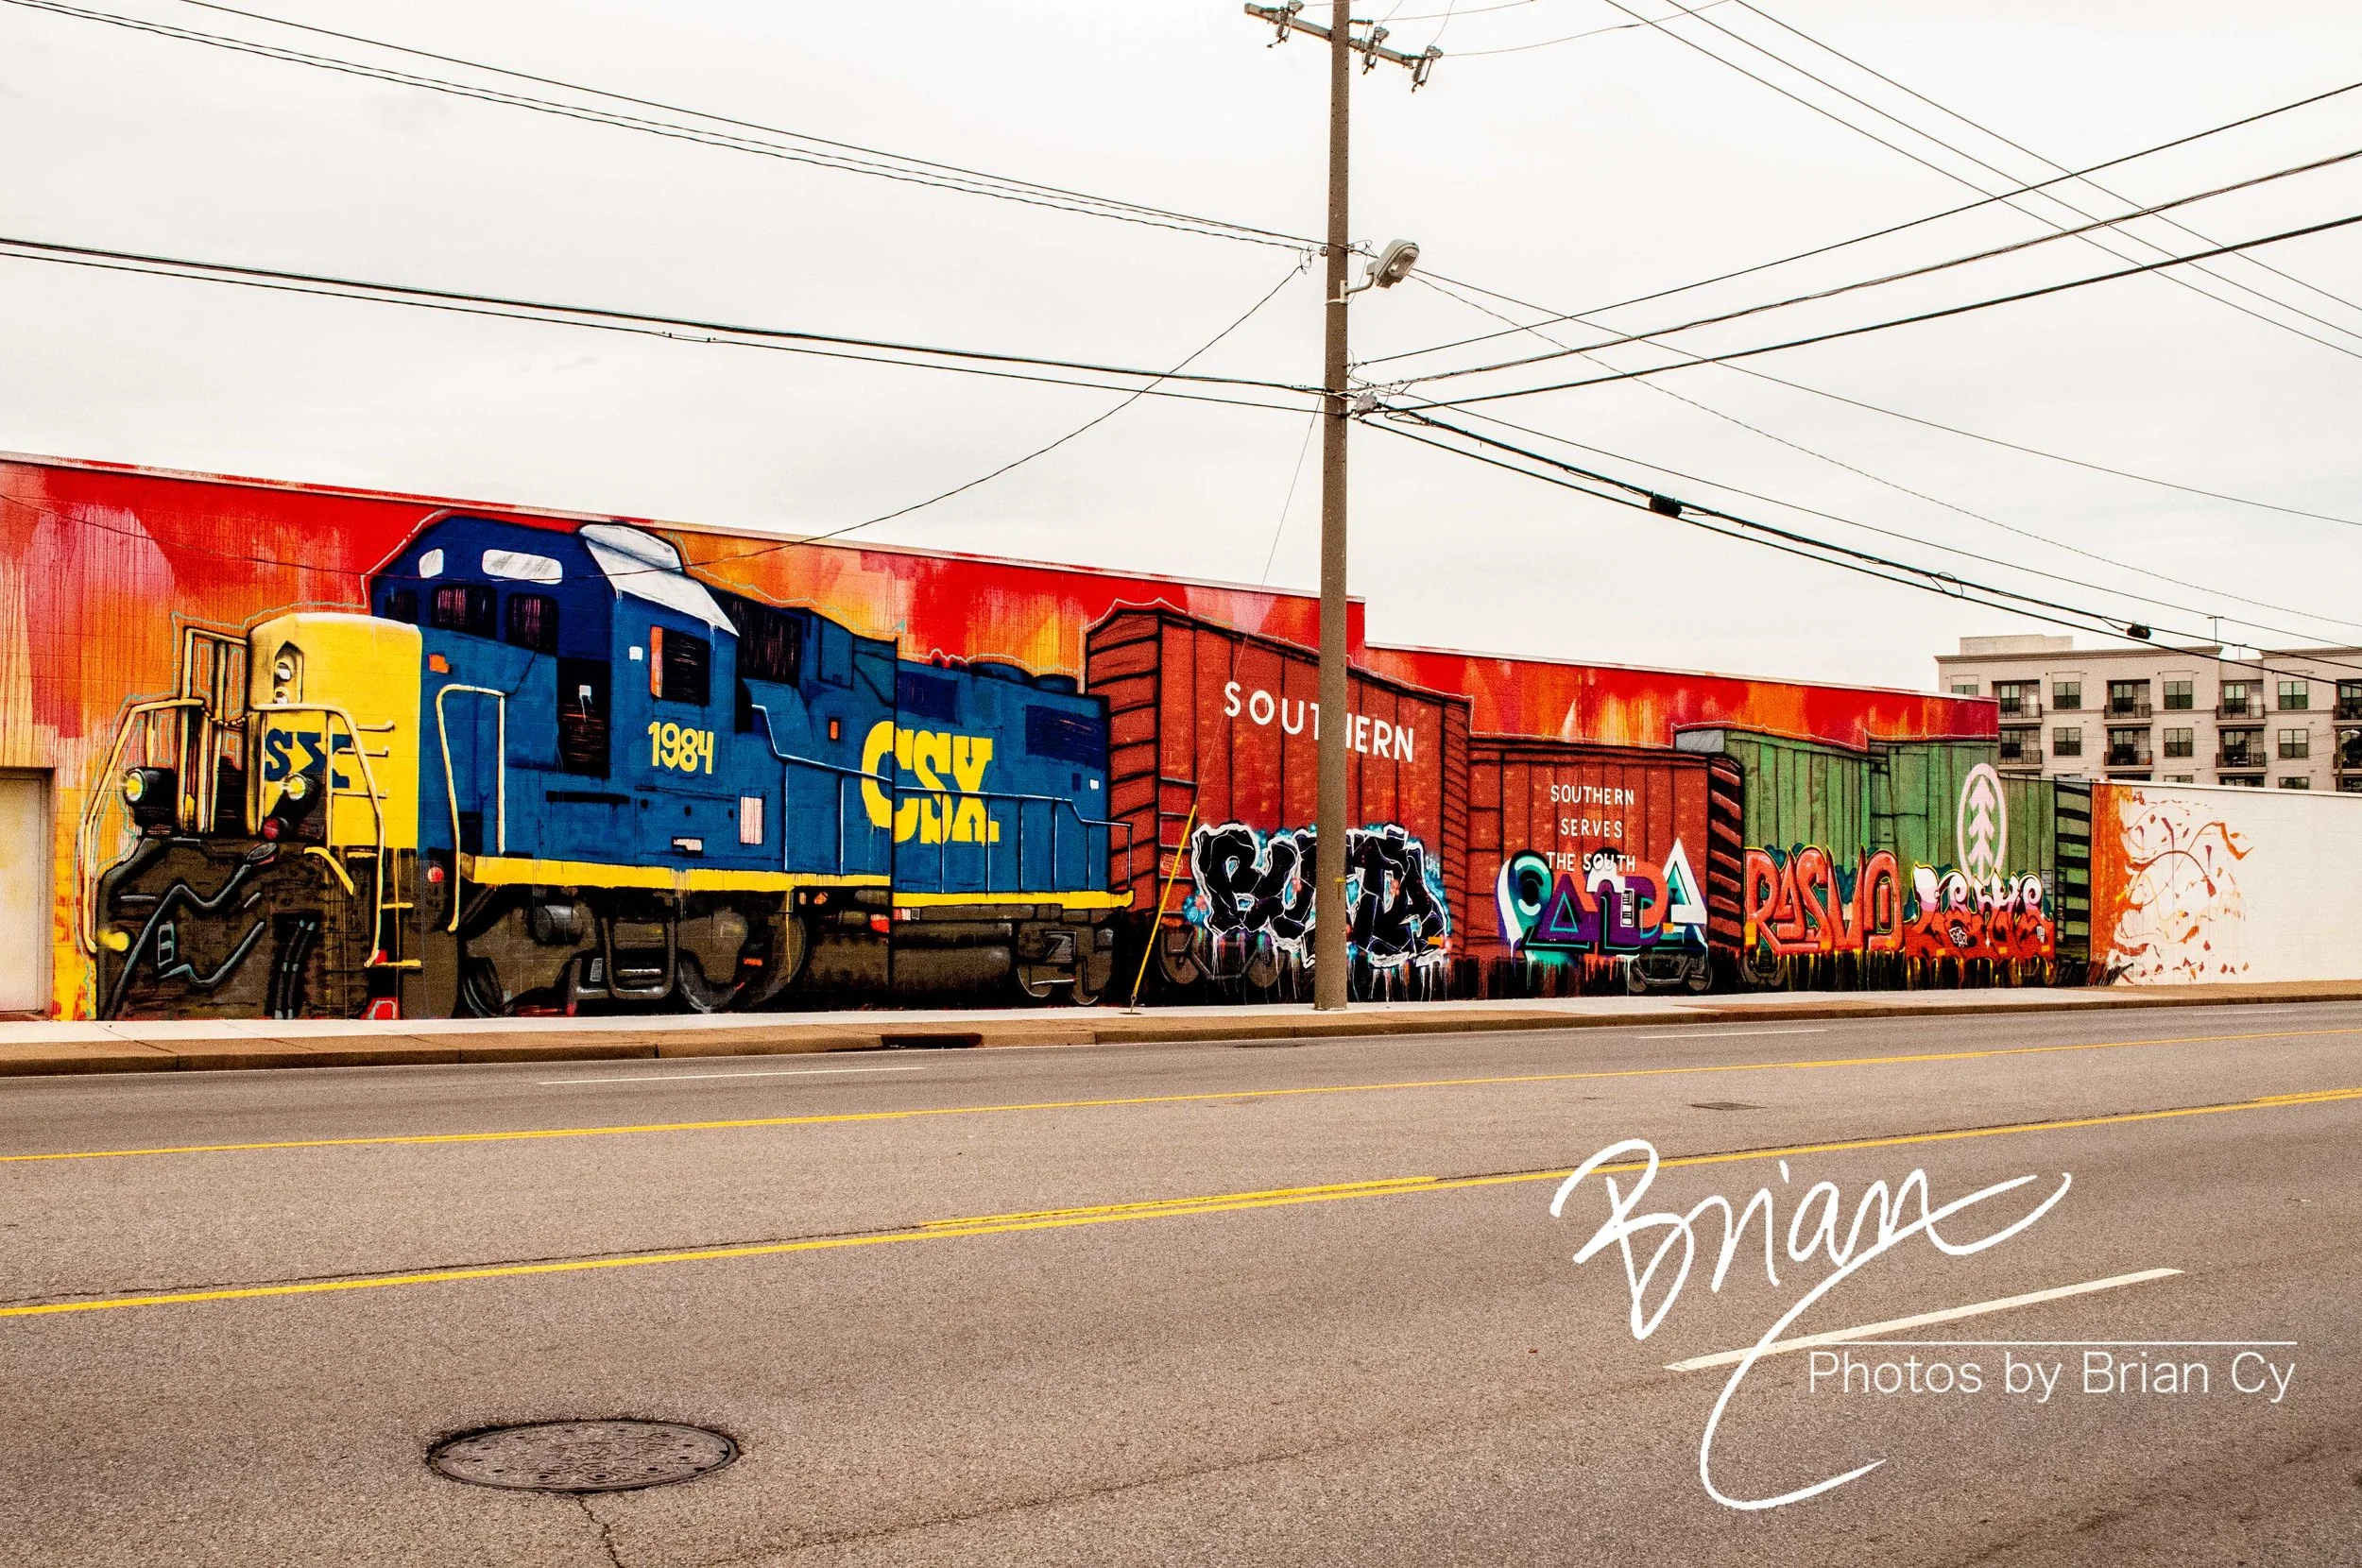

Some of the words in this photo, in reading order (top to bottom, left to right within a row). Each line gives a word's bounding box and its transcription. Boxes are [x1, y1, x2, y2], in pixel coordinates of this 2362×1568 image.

[648, 721, 713, 775] 1984
[861, 720, 1001, 846] CSX
[1550, 784, 1635, 806] SOUTHERN
[1560, 818, 1623, 839] SERVES
[1546, 851, 1576, 872] THE
[1583, 852, 1636, 873] SOUTH
